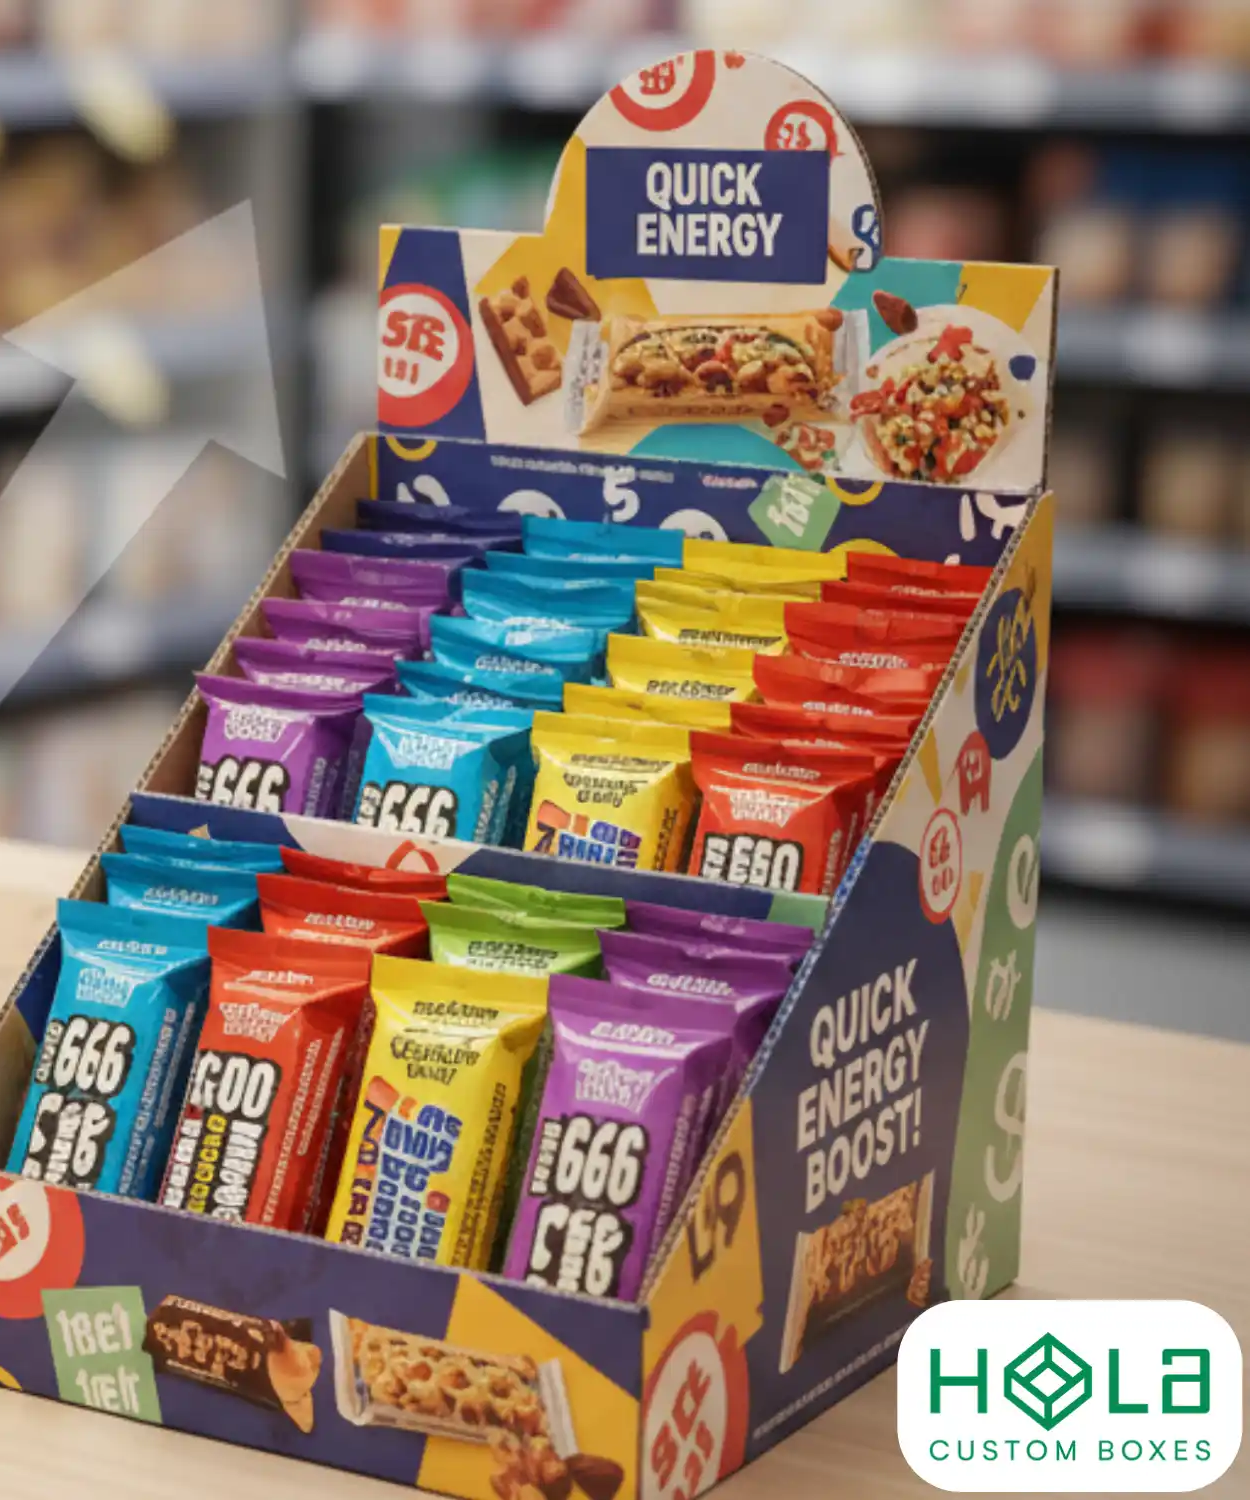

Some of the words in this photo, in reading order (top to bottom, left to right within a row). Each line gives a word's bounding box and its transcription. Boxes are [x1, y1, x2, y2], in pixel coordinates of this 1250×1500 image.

[637, 211, 784, 257] ENERGY
[646, 161, 762, 211] QUICK
[810, 957, 919, 1068] QUICK
[797, 1019, 930, 1152] ENERGY
[805, 1101, 922, 1213] BOOST!
